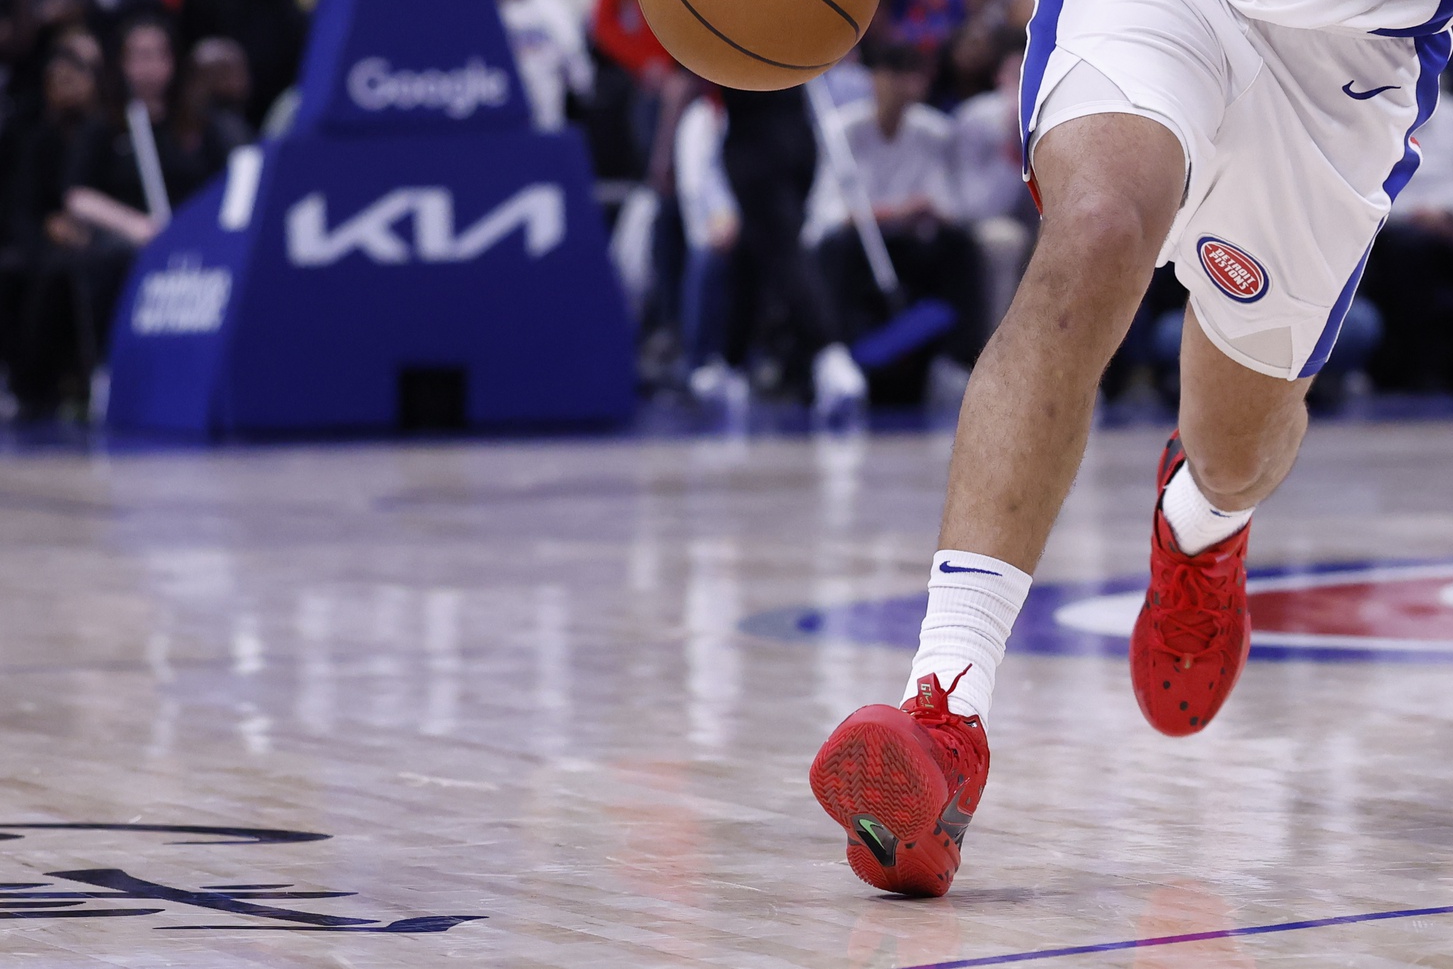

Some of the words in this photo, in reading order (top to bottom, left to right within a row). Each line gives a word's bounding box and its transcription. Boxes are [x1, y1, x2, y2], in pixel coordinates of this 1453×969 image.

[347, 57, 507, 118] Google
[1209, 251, 1249, 290] PISTONS
[1215, 248, 1256, 284] DETROIT
